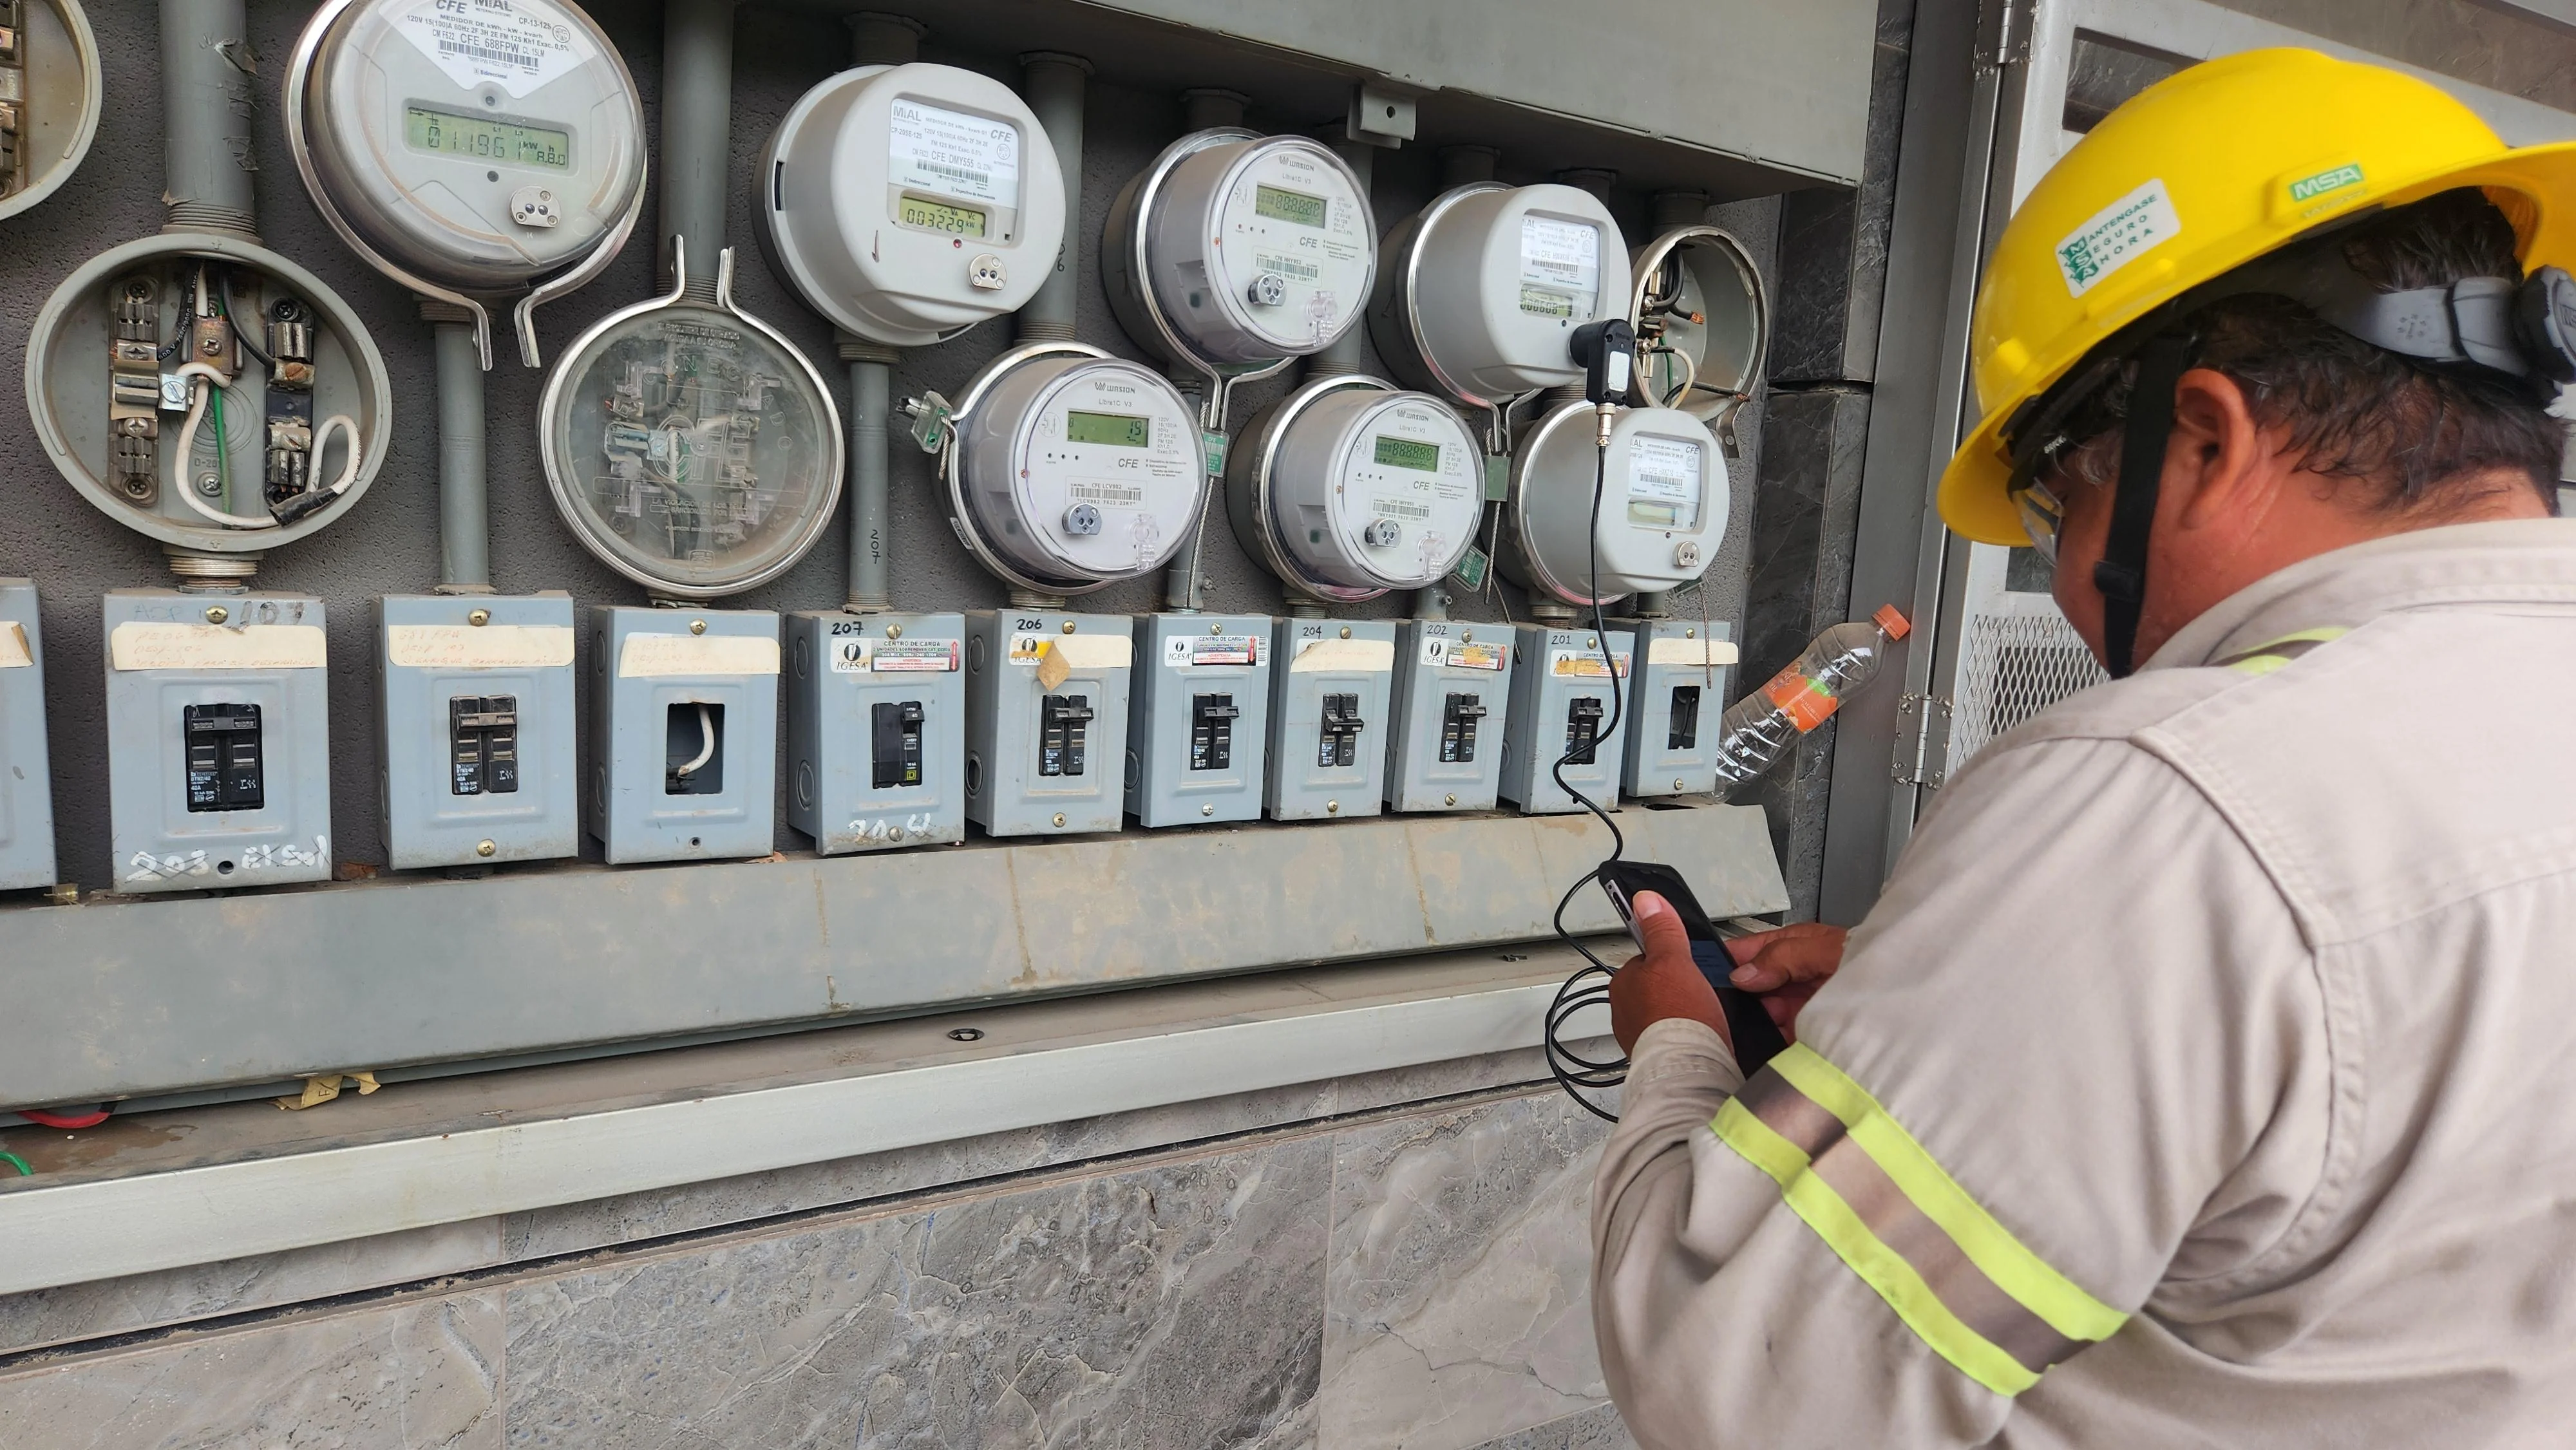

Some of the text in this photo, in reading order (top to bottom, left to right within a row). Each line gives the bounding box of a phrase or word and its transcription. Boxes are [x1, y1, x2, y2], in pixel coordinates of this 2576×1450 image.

[436, 0, 467, 14] CFE
[407, 15, 423, 23] 120V
[454, 24, 469, 33] 60Hz
[440, 14, 474, 25] MEDIDOR
[460, 33, 480, 46] CFE
[484, 38, 520, 53] 688FPW
[990, 129, 1013, 142] CFE
[931, 150, 947, 163] CFE
[2294, 167, 2361, 200] MSA
[906, 207, 965, 234] 003229
[1580, 230, 1595, 240] CFE
[1299, 236, 1318, 249] CFE
[1685, 446, 1700, 455] CFE
[1118, 458, 1139, 469] CFE
[1414, 480, 1430, 491] CFE
[831, 621, 864, 636] 207
[1016, 618, 1043, 630] 206
[1426, 624, 1448, 636] 202
[1303, 625, 1321, 639] 204
[1551, 634, 1572, 645] 201
[837, 661, 867, 670] IGESA
